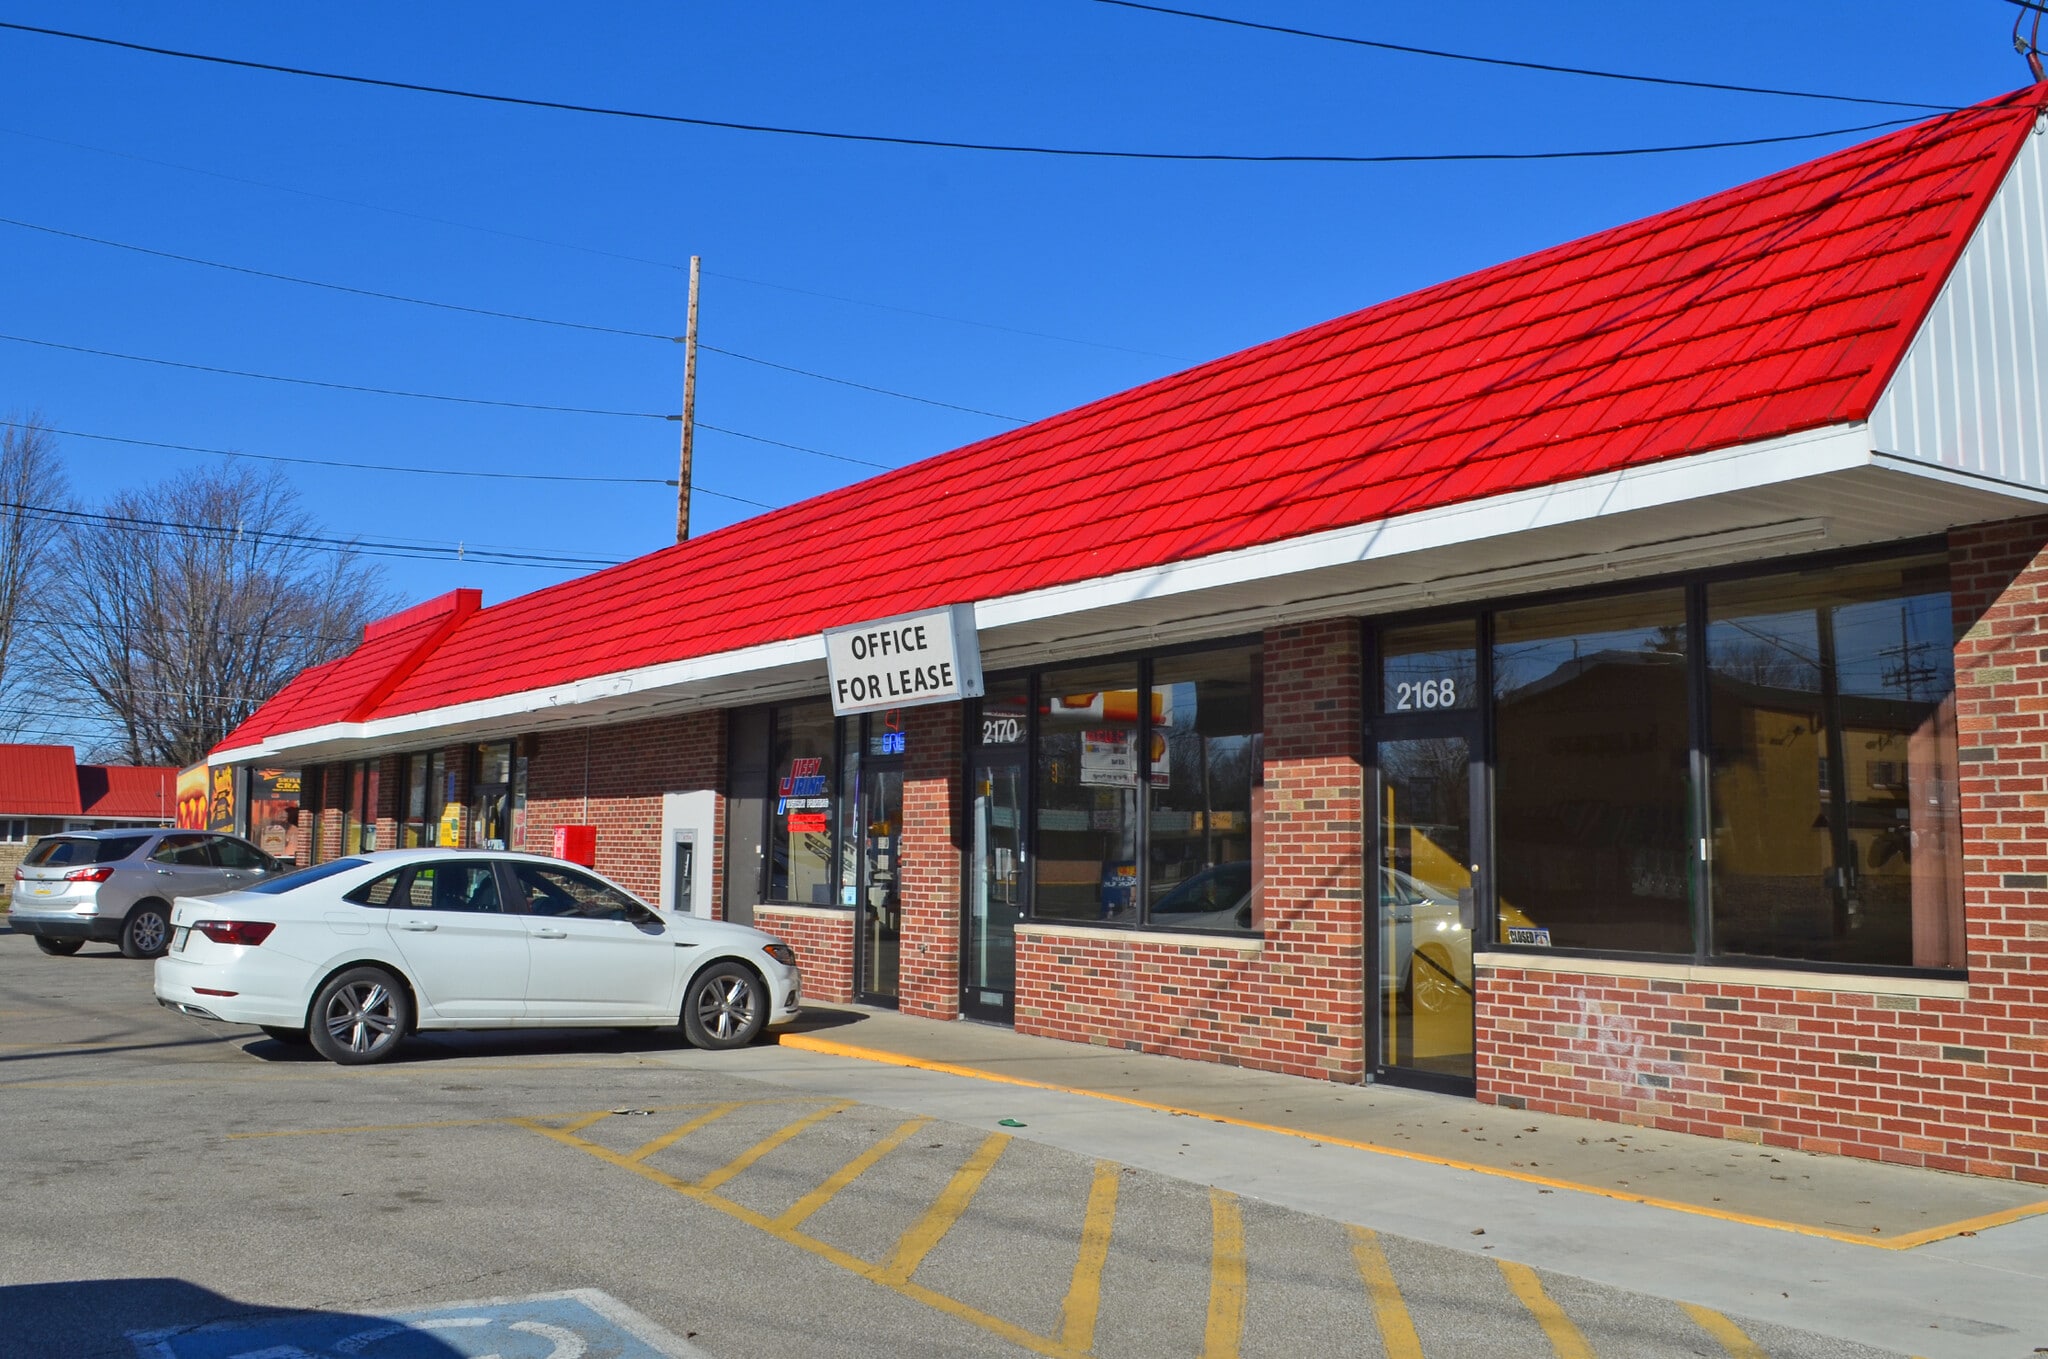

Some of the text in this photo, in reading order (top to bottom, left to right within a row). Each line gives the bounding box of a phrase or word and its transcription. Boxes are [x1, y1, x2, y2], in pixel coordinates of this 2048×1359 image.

[851, 625, 928, 660] OFFICE
[836, 662, 954, 704] FOR LEASE
[1396, 678, 1456, 710] 2168
[982, 718, 1018, 744] 2170
[779, 757, 823, 797] JIFFY
[1509, 929, 1535, 944] CLOSED
